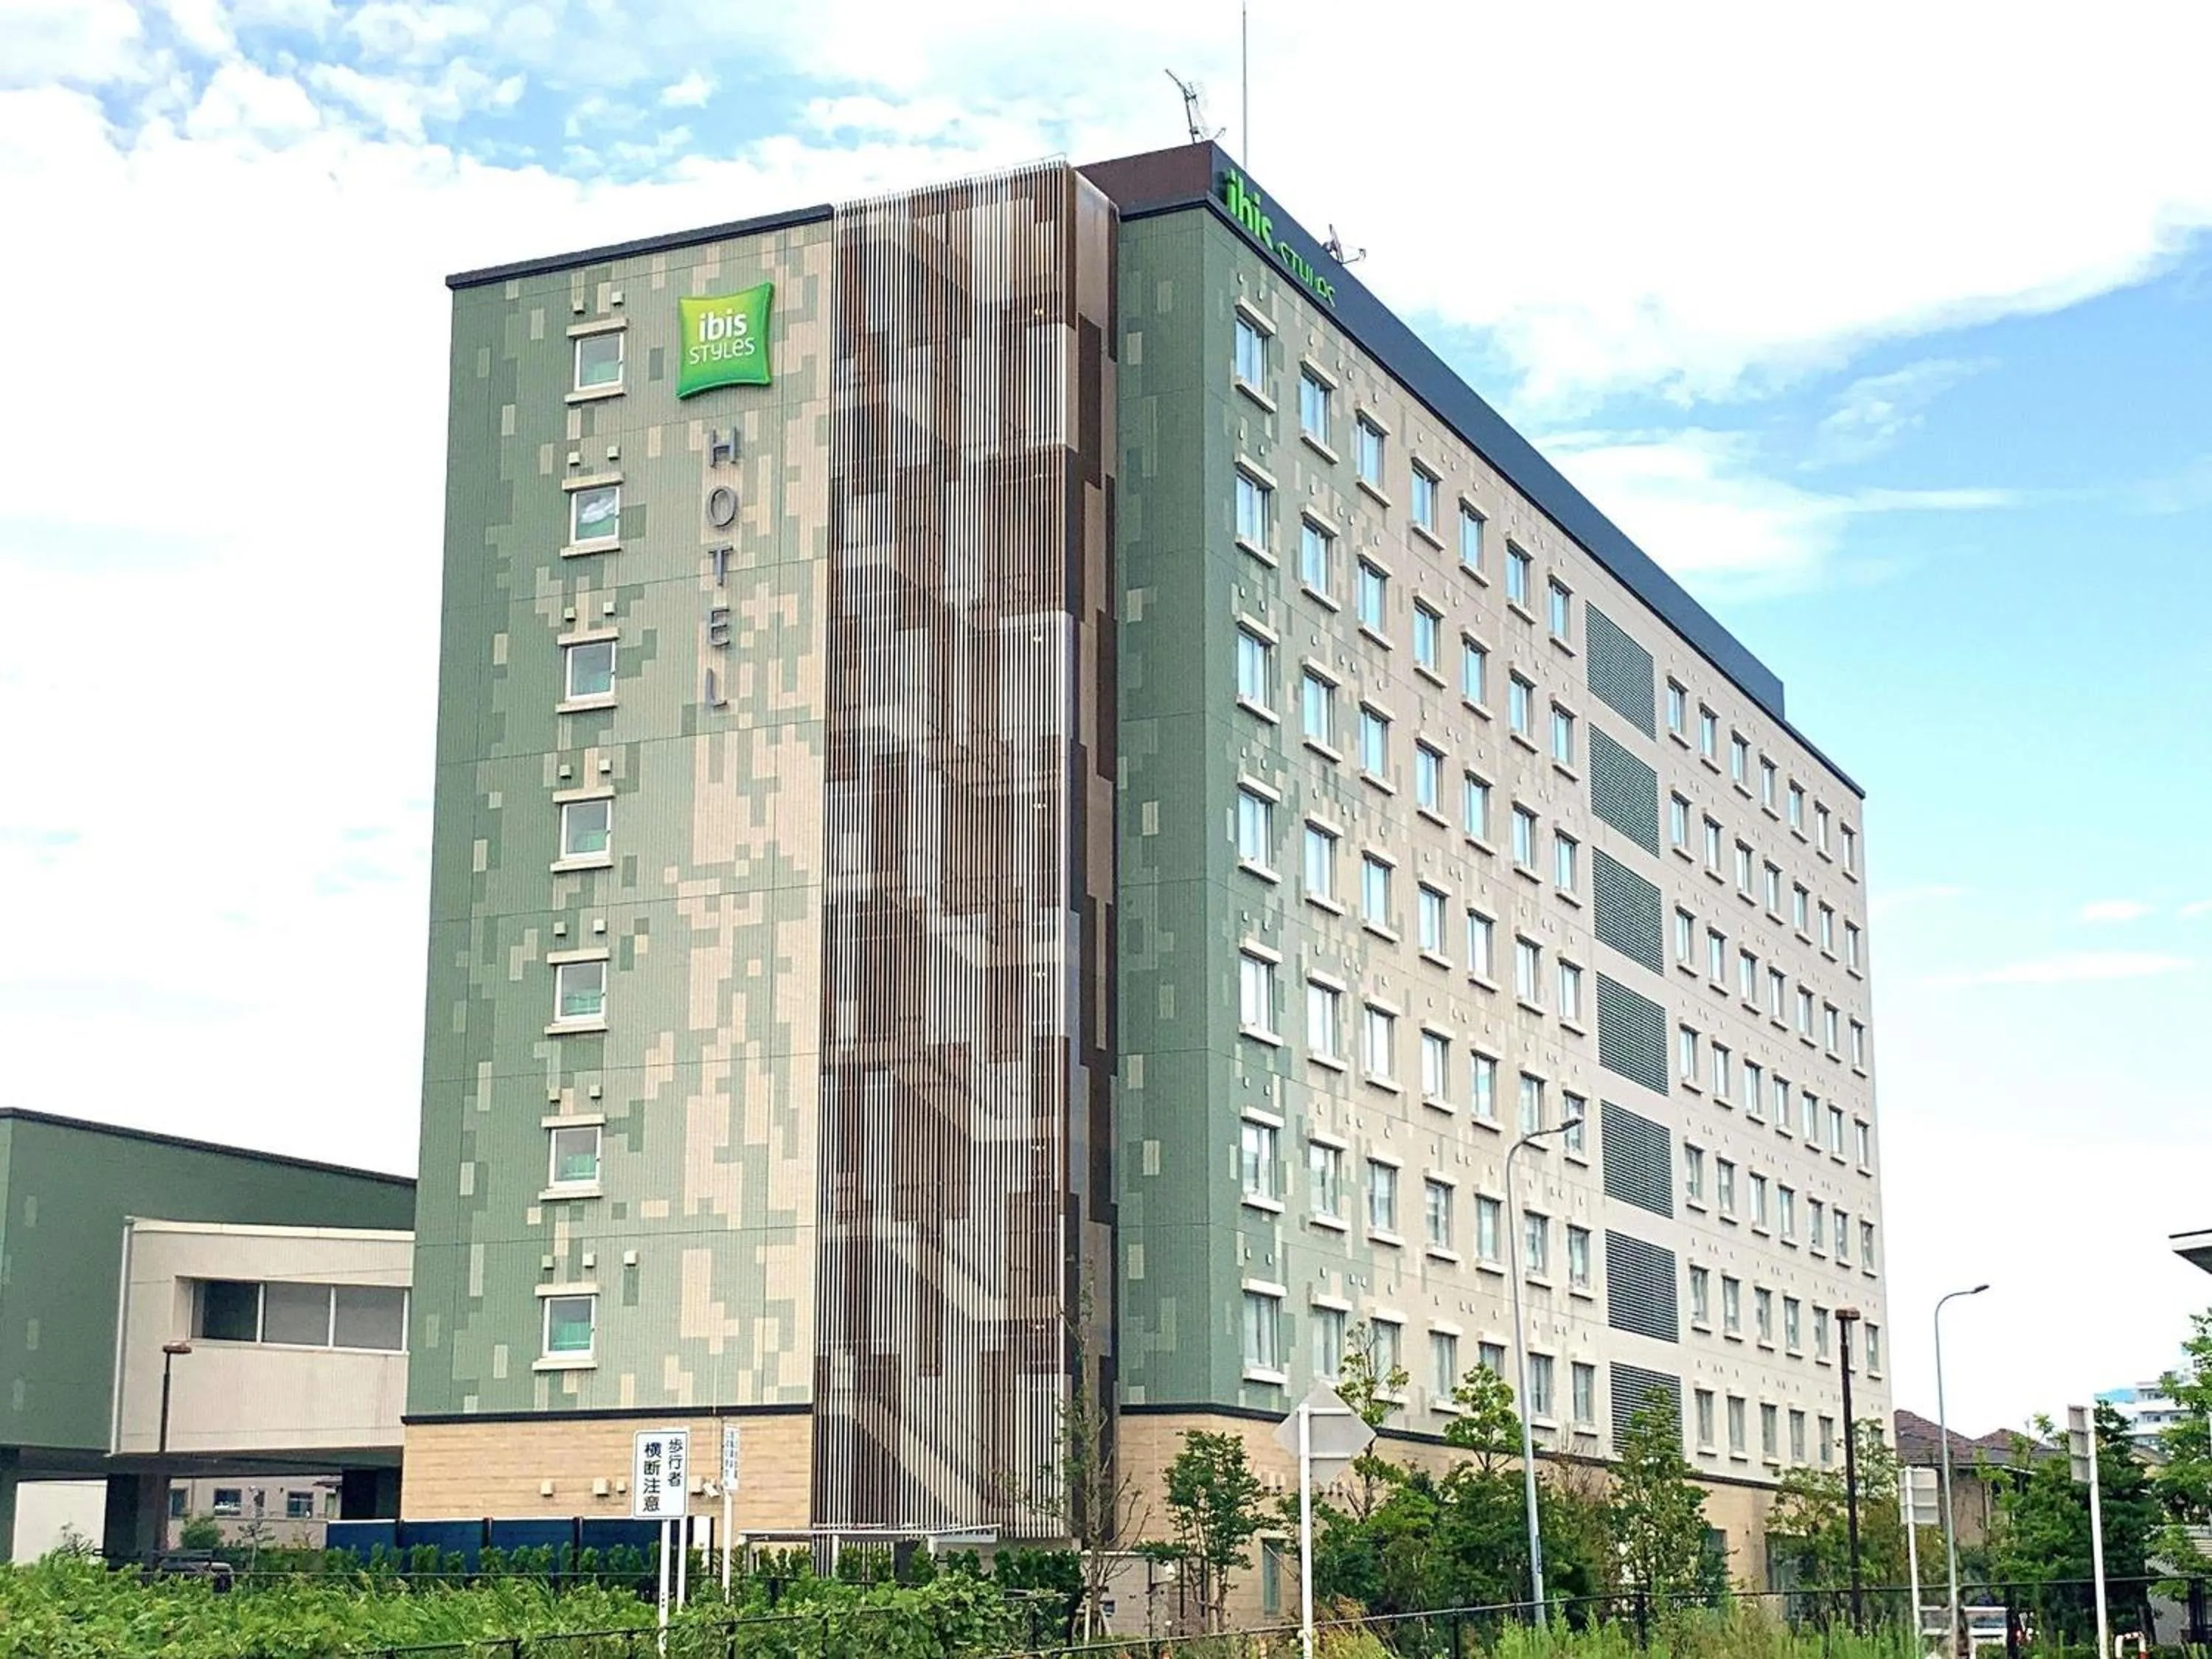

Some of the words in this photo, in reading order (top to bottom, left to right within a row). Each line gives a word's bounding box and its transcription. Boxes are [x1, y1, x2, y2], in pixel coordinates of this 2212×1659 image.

[699, 308, 747, 342] ibis
[706, 426, 738, 709] HOTEL
[643, 1441, 662, 1512] 横断注意
[668, 1437, 684, 1487] 歩行者
